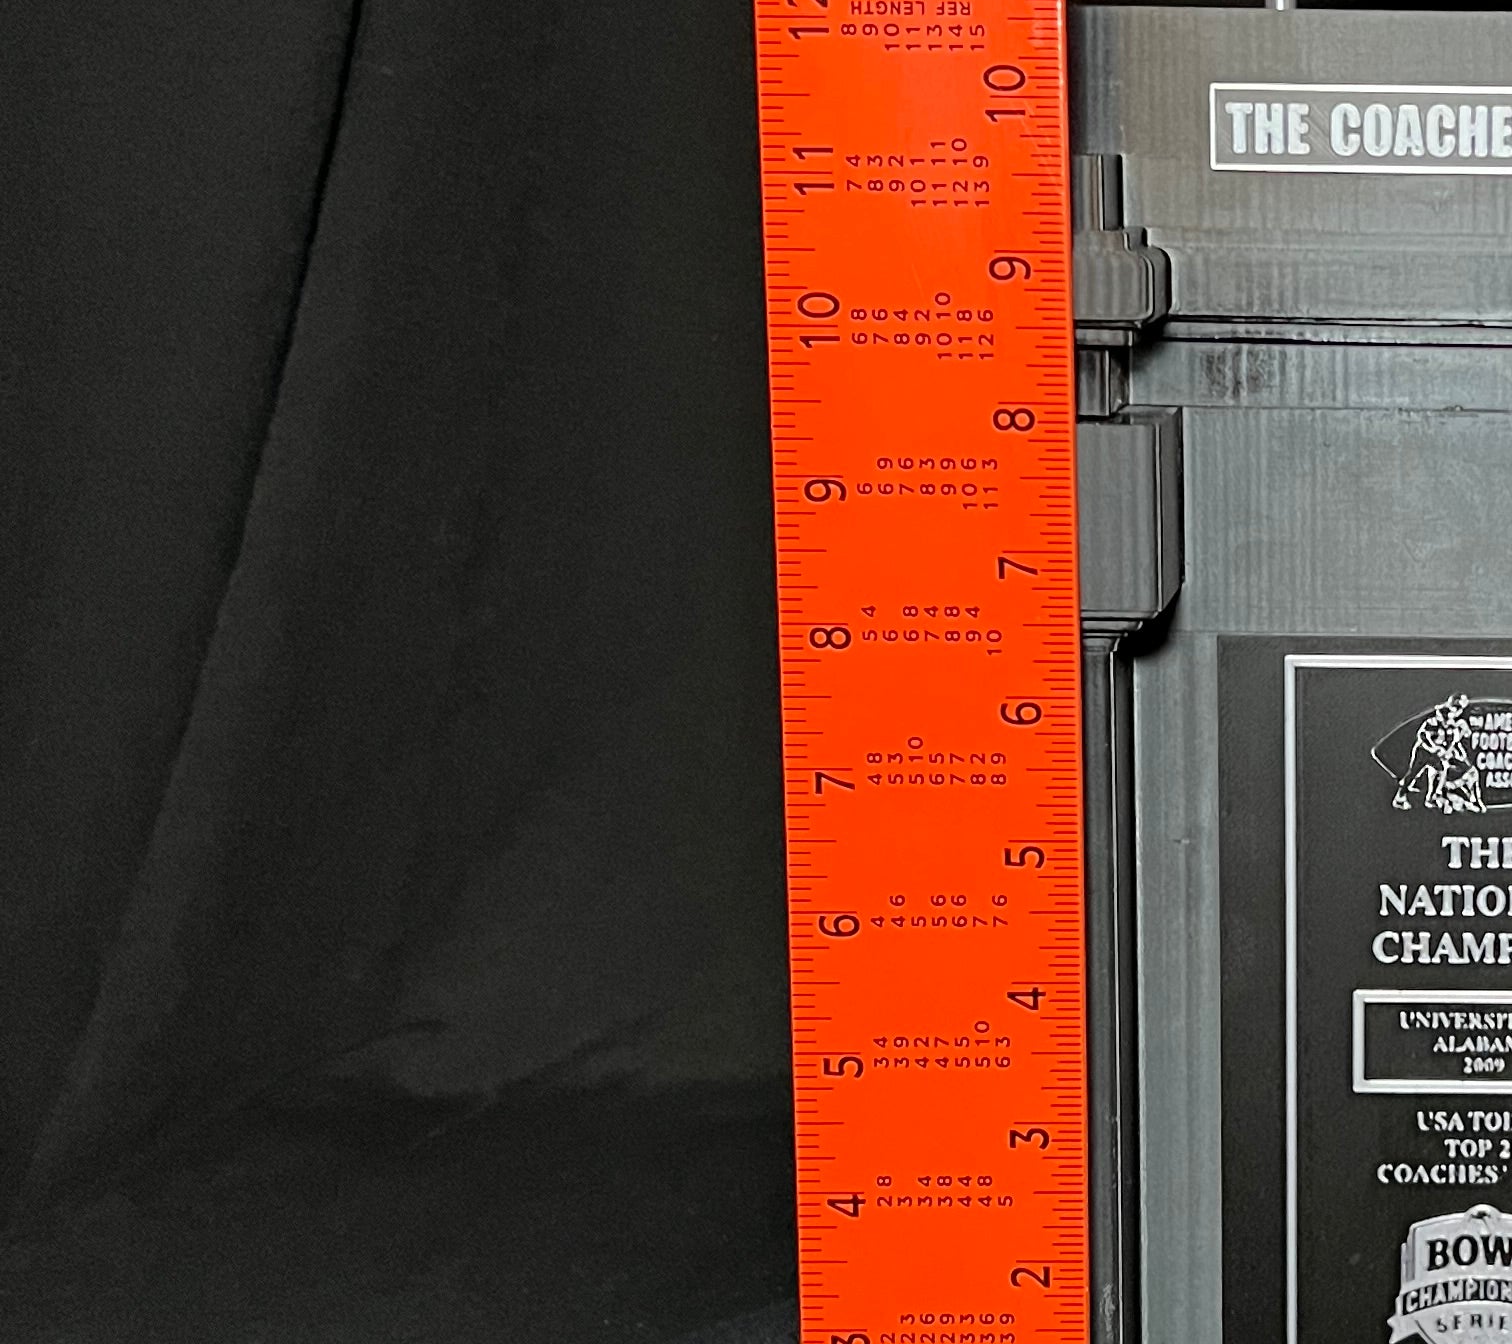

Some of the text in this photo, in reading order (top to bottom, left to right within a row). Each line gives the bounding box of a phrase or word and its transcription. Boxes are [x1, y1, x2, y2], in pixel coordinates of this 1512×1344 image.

[851, 1, 970, 15] REF LENGTH
[841, 24, 856, 35] 8
[862, 24, 878, 35] 9
[884, 24, 899, 50] 10
[906, 28, 921, 50] 11
[927, 25, 942, 50] 13
[949, 25, 963, 51] 14
[970, 25, 984, 50] 15
[983, 65, 1026, 122] 10
[1225, 102, 1311, 155] THE
[793, 148, 834, 195] 11
[989, 257, 1031, 280] 9
[797, 292, 840, 348] 10
[993, 408, 1035, 431] 8
[804, 479, 846, 502] 9
[998, 557, 1038, 579] 7
[809, 627, 851, 649] 8
[1000, 702, 1042, 725] 6
[815, 772, 855, 794] 7
[1005, 846, 1045, 868] 5
[819, 915, 860, 937] 6
[1007, 987, 1046, 1010] 4
[873, 1037, 889, 1068] 3 4
[894, 1037, 909, 1068] 3 9
[914, 1037, 929, 1068] 4 2
[934, 1037, 949, 1068] 4 7
[955, 1037, 970, 1068] 5 5
[974, 1021, 990, 1068] 5 10
[995, 1037, 1010, 1067] 6 3
[823, 1056, 863, 1078] 5
[1463, 1056, 1506, 1074] 2009
[1417, 1111, 1464, 1132] USA
[1009, 1128, 1049, 1149] 3
[1443, 1138, 1493, 1158] TOP
[1377, 1163, 1508, 1184] COACHES'
[823, 1192, 866, 1217] 4
[1011, 1266, 1050, 1288] 2
